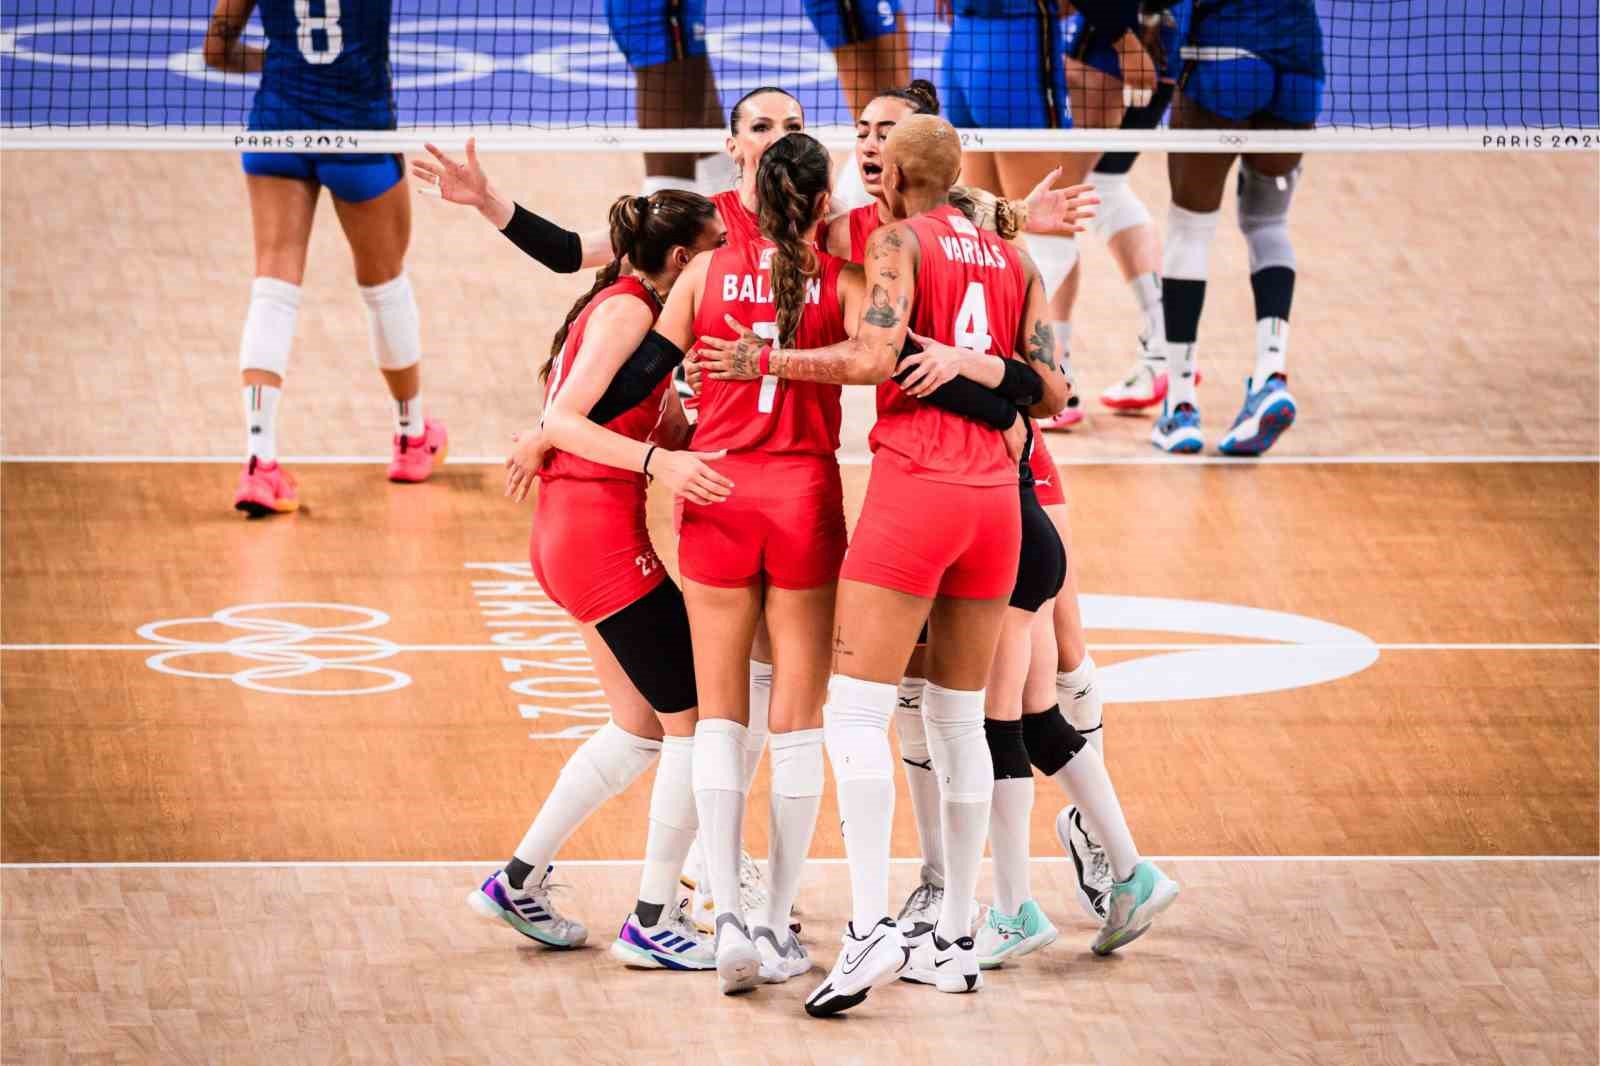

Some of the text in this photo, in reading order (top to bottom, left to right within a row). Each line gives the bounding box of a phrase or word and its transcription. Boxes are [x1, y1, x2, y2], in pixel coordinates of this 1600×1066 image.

[294, 0, 342, 65] 8
[234, 135, 358, 149] PARIS 2024
[1482, 135, 1542, 148] PARIS
[937, 234, 1007, 269] VARGAS
[953, 281, 993, 352] 4
